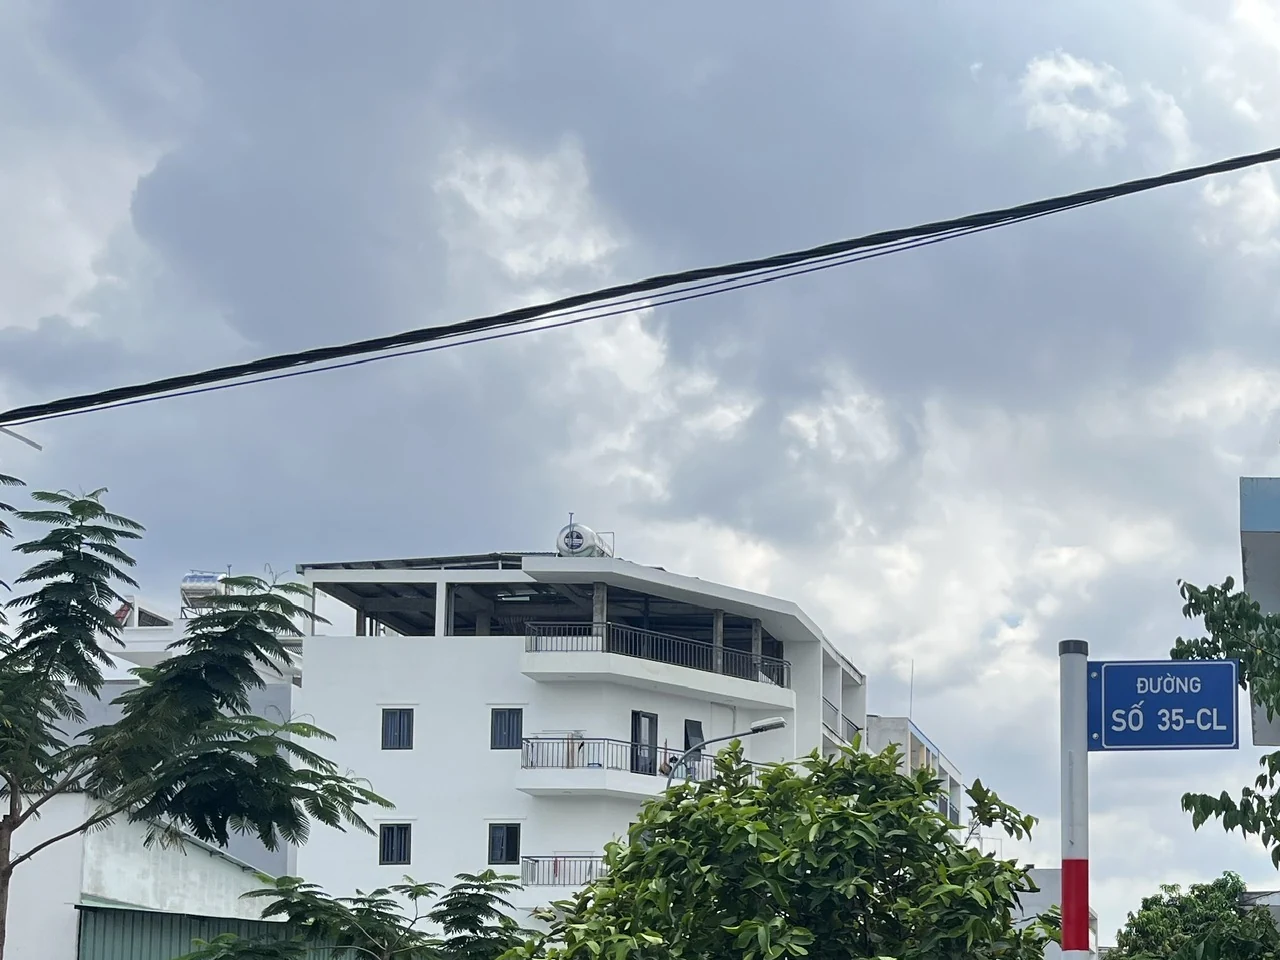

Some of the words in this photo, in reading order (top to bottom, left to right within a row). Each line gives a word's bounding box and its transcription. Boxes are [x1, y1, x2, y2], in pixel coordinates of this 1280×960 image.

[1136, 673, 1201, 693] ĐƯỜNG
[1111, 700, 1144, 731] SỐ
[1157, 708, 1227, 731] 35-CL
